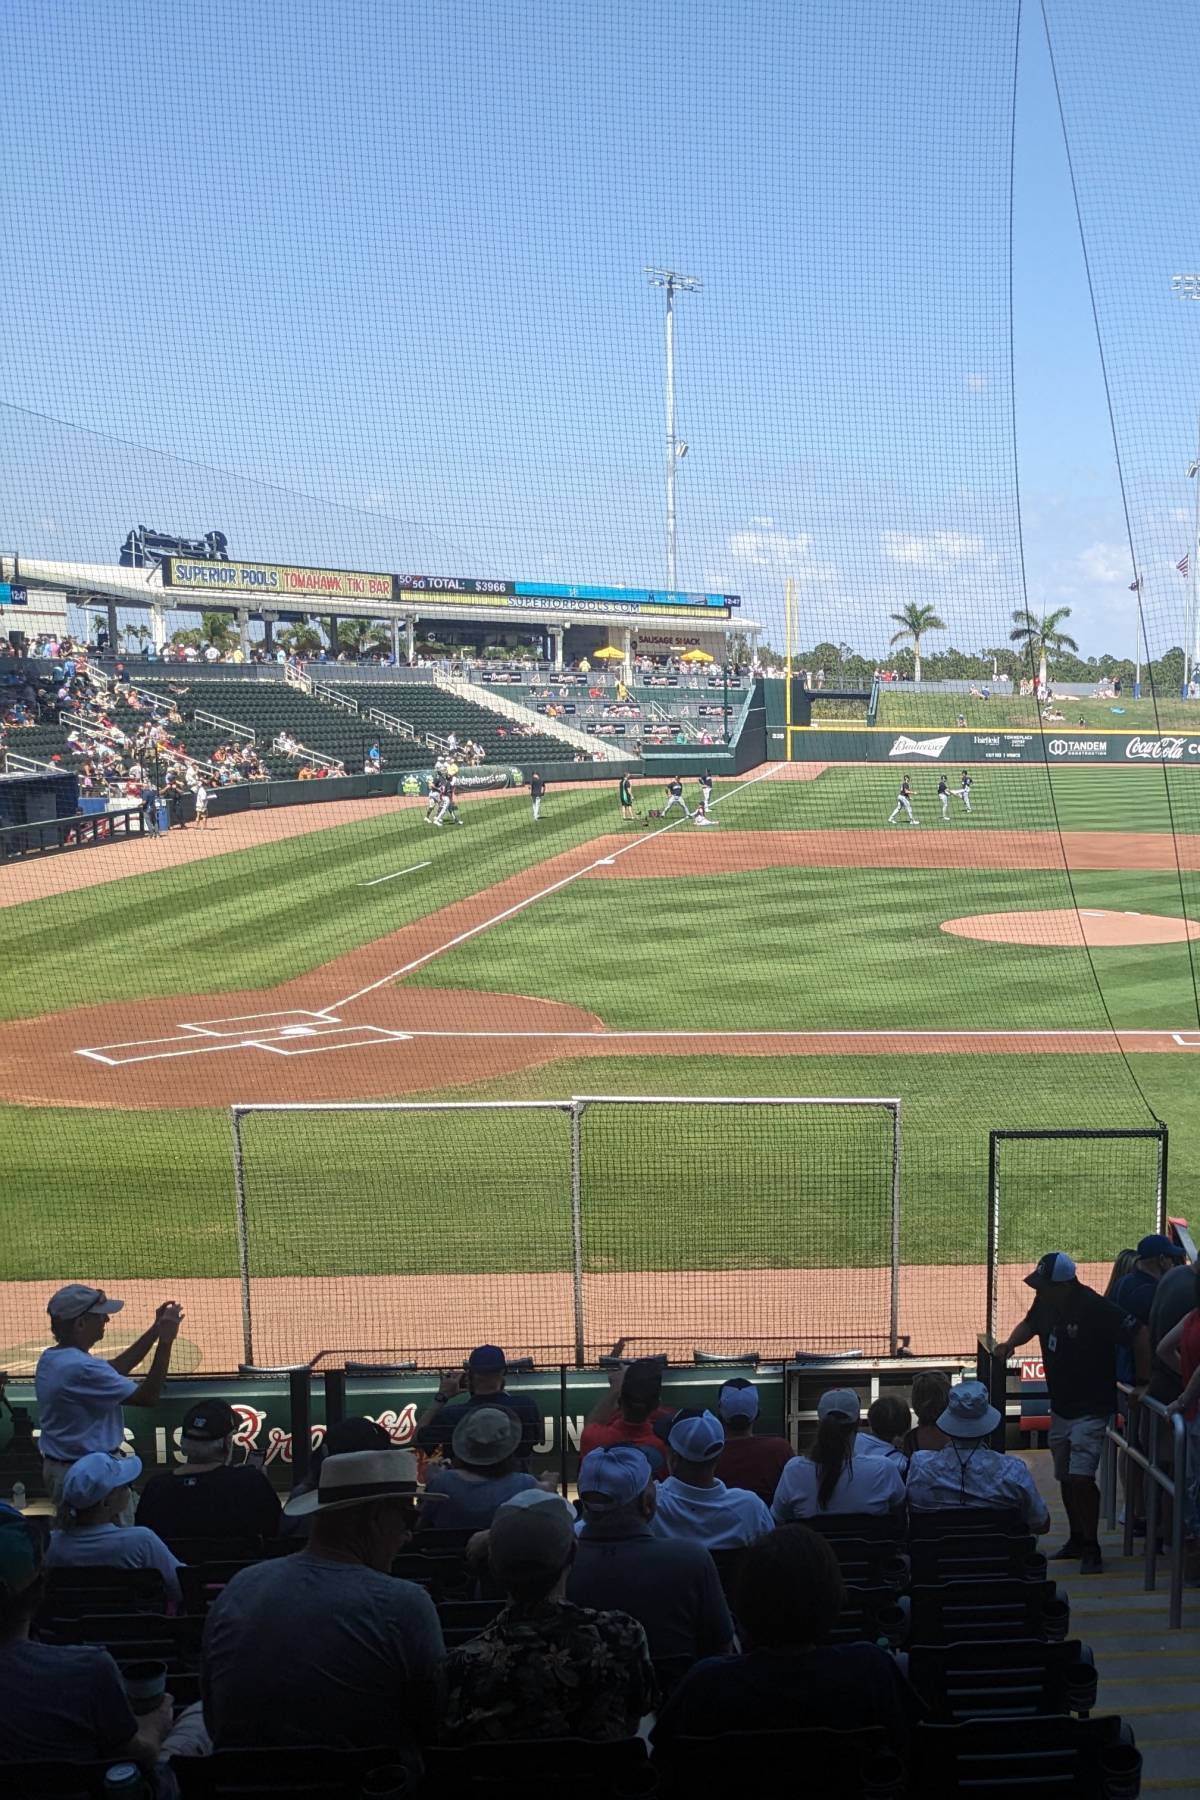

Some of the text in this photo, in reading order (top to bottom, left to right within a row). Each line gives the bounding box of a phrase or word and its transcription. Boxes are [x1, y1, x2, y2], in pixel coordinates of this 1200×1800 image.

[175, 564, 390, 594] SUPERIOR POOLS TOMAHAWK TIKI BAR
[427, 578, 506, 593] TOTAL: $3966
[508, 597, 640, 612] SUPERIORPOOLS.COM
[639, 636, 700, 645] SAUSAGE SHACK
[895, 740, 943, 751] Budweiser
[1068, 742, 1107, 751] TANDEM
